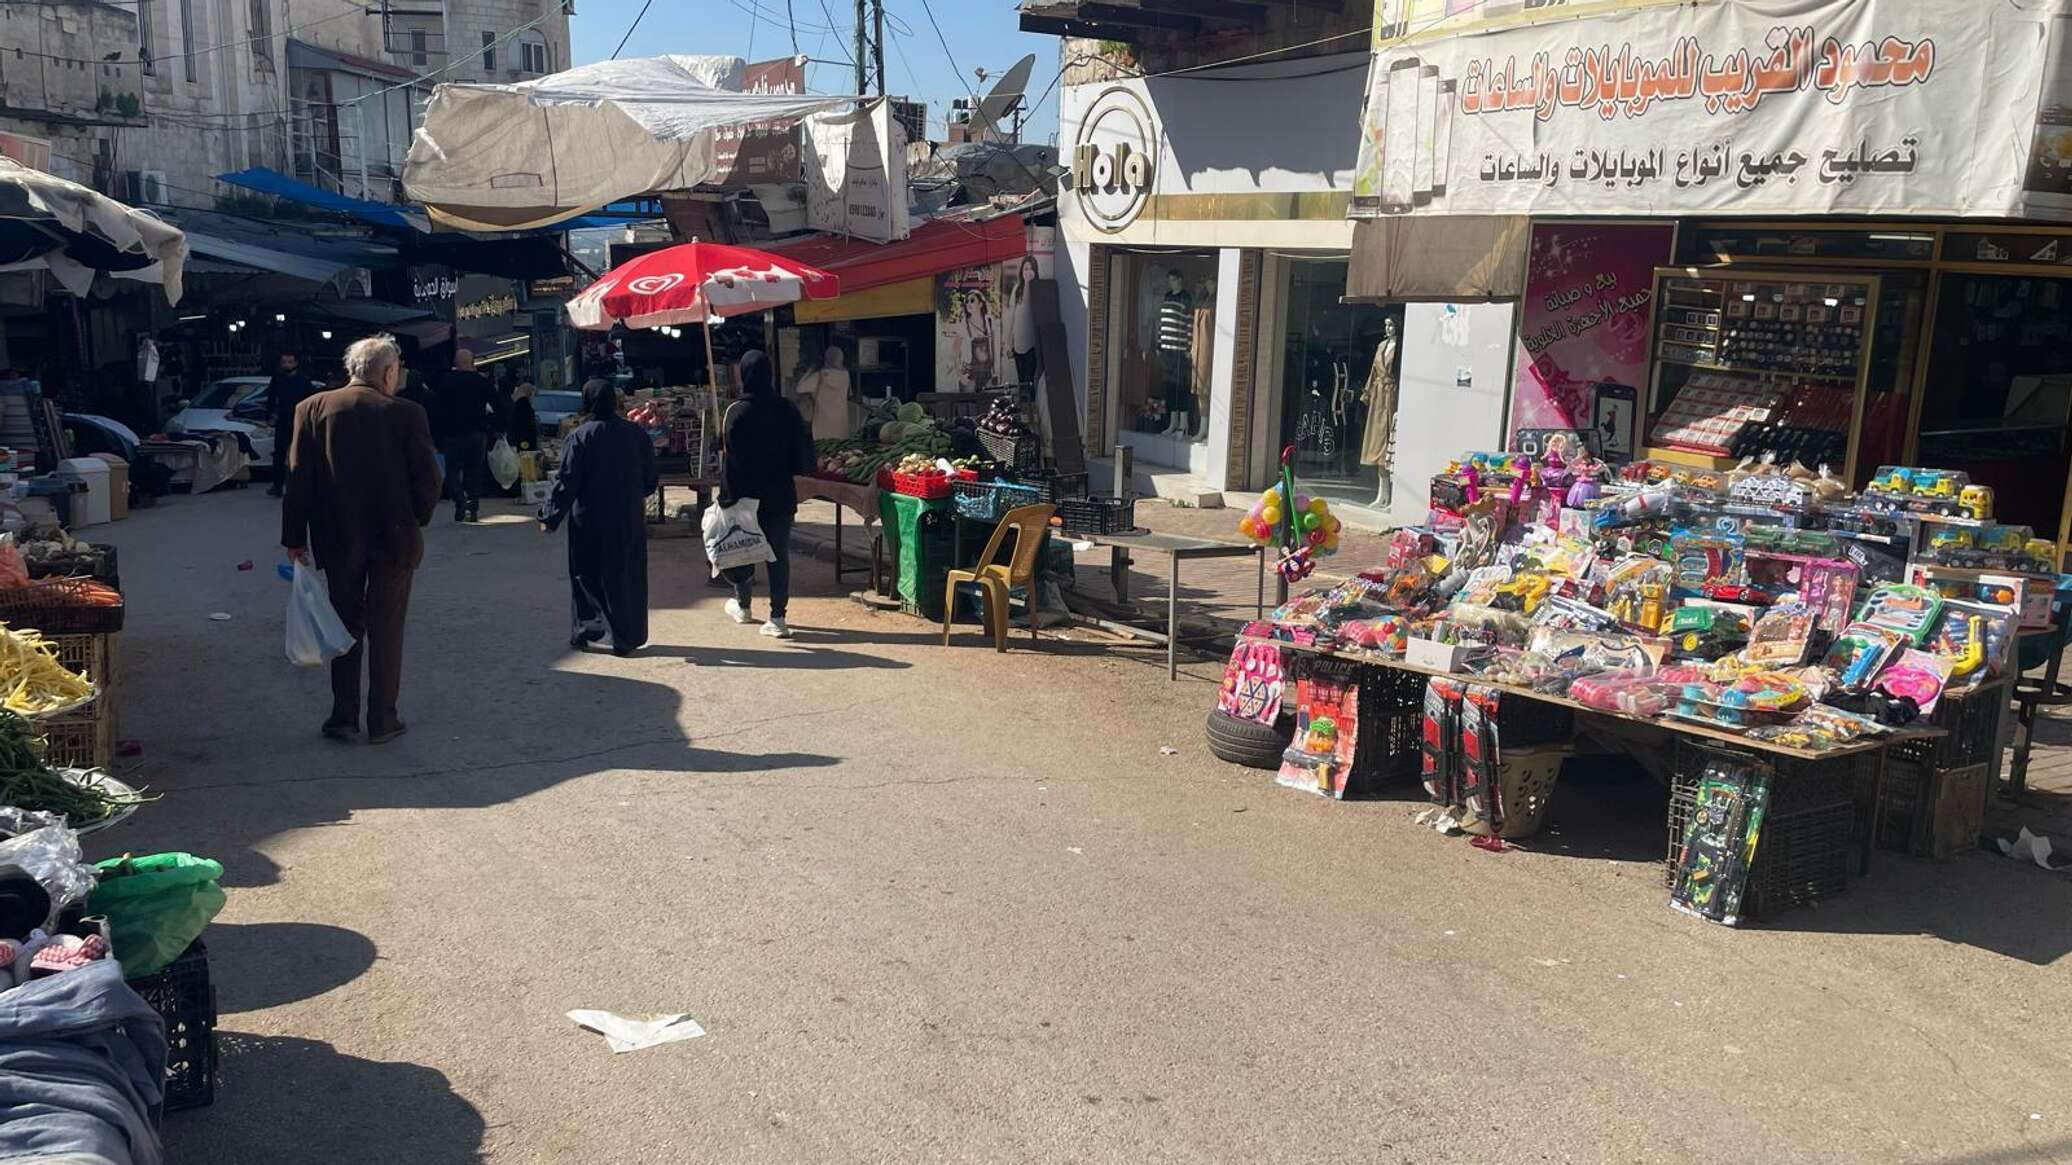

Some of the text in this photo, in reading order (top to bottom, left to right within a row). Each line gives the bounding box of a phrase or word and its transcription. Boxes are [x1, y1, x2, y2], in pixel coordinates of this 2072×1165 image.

[1461, 26, 1936, 122] محمود القريب للموبايلات والساعات
[1072, 143, 1145, 188] Hola
[1480, 136, 1918, 188] تصليح جميع أنواع الموبايلات والساعات
[1544, 272, 1618, 313] بيع و صيانة
